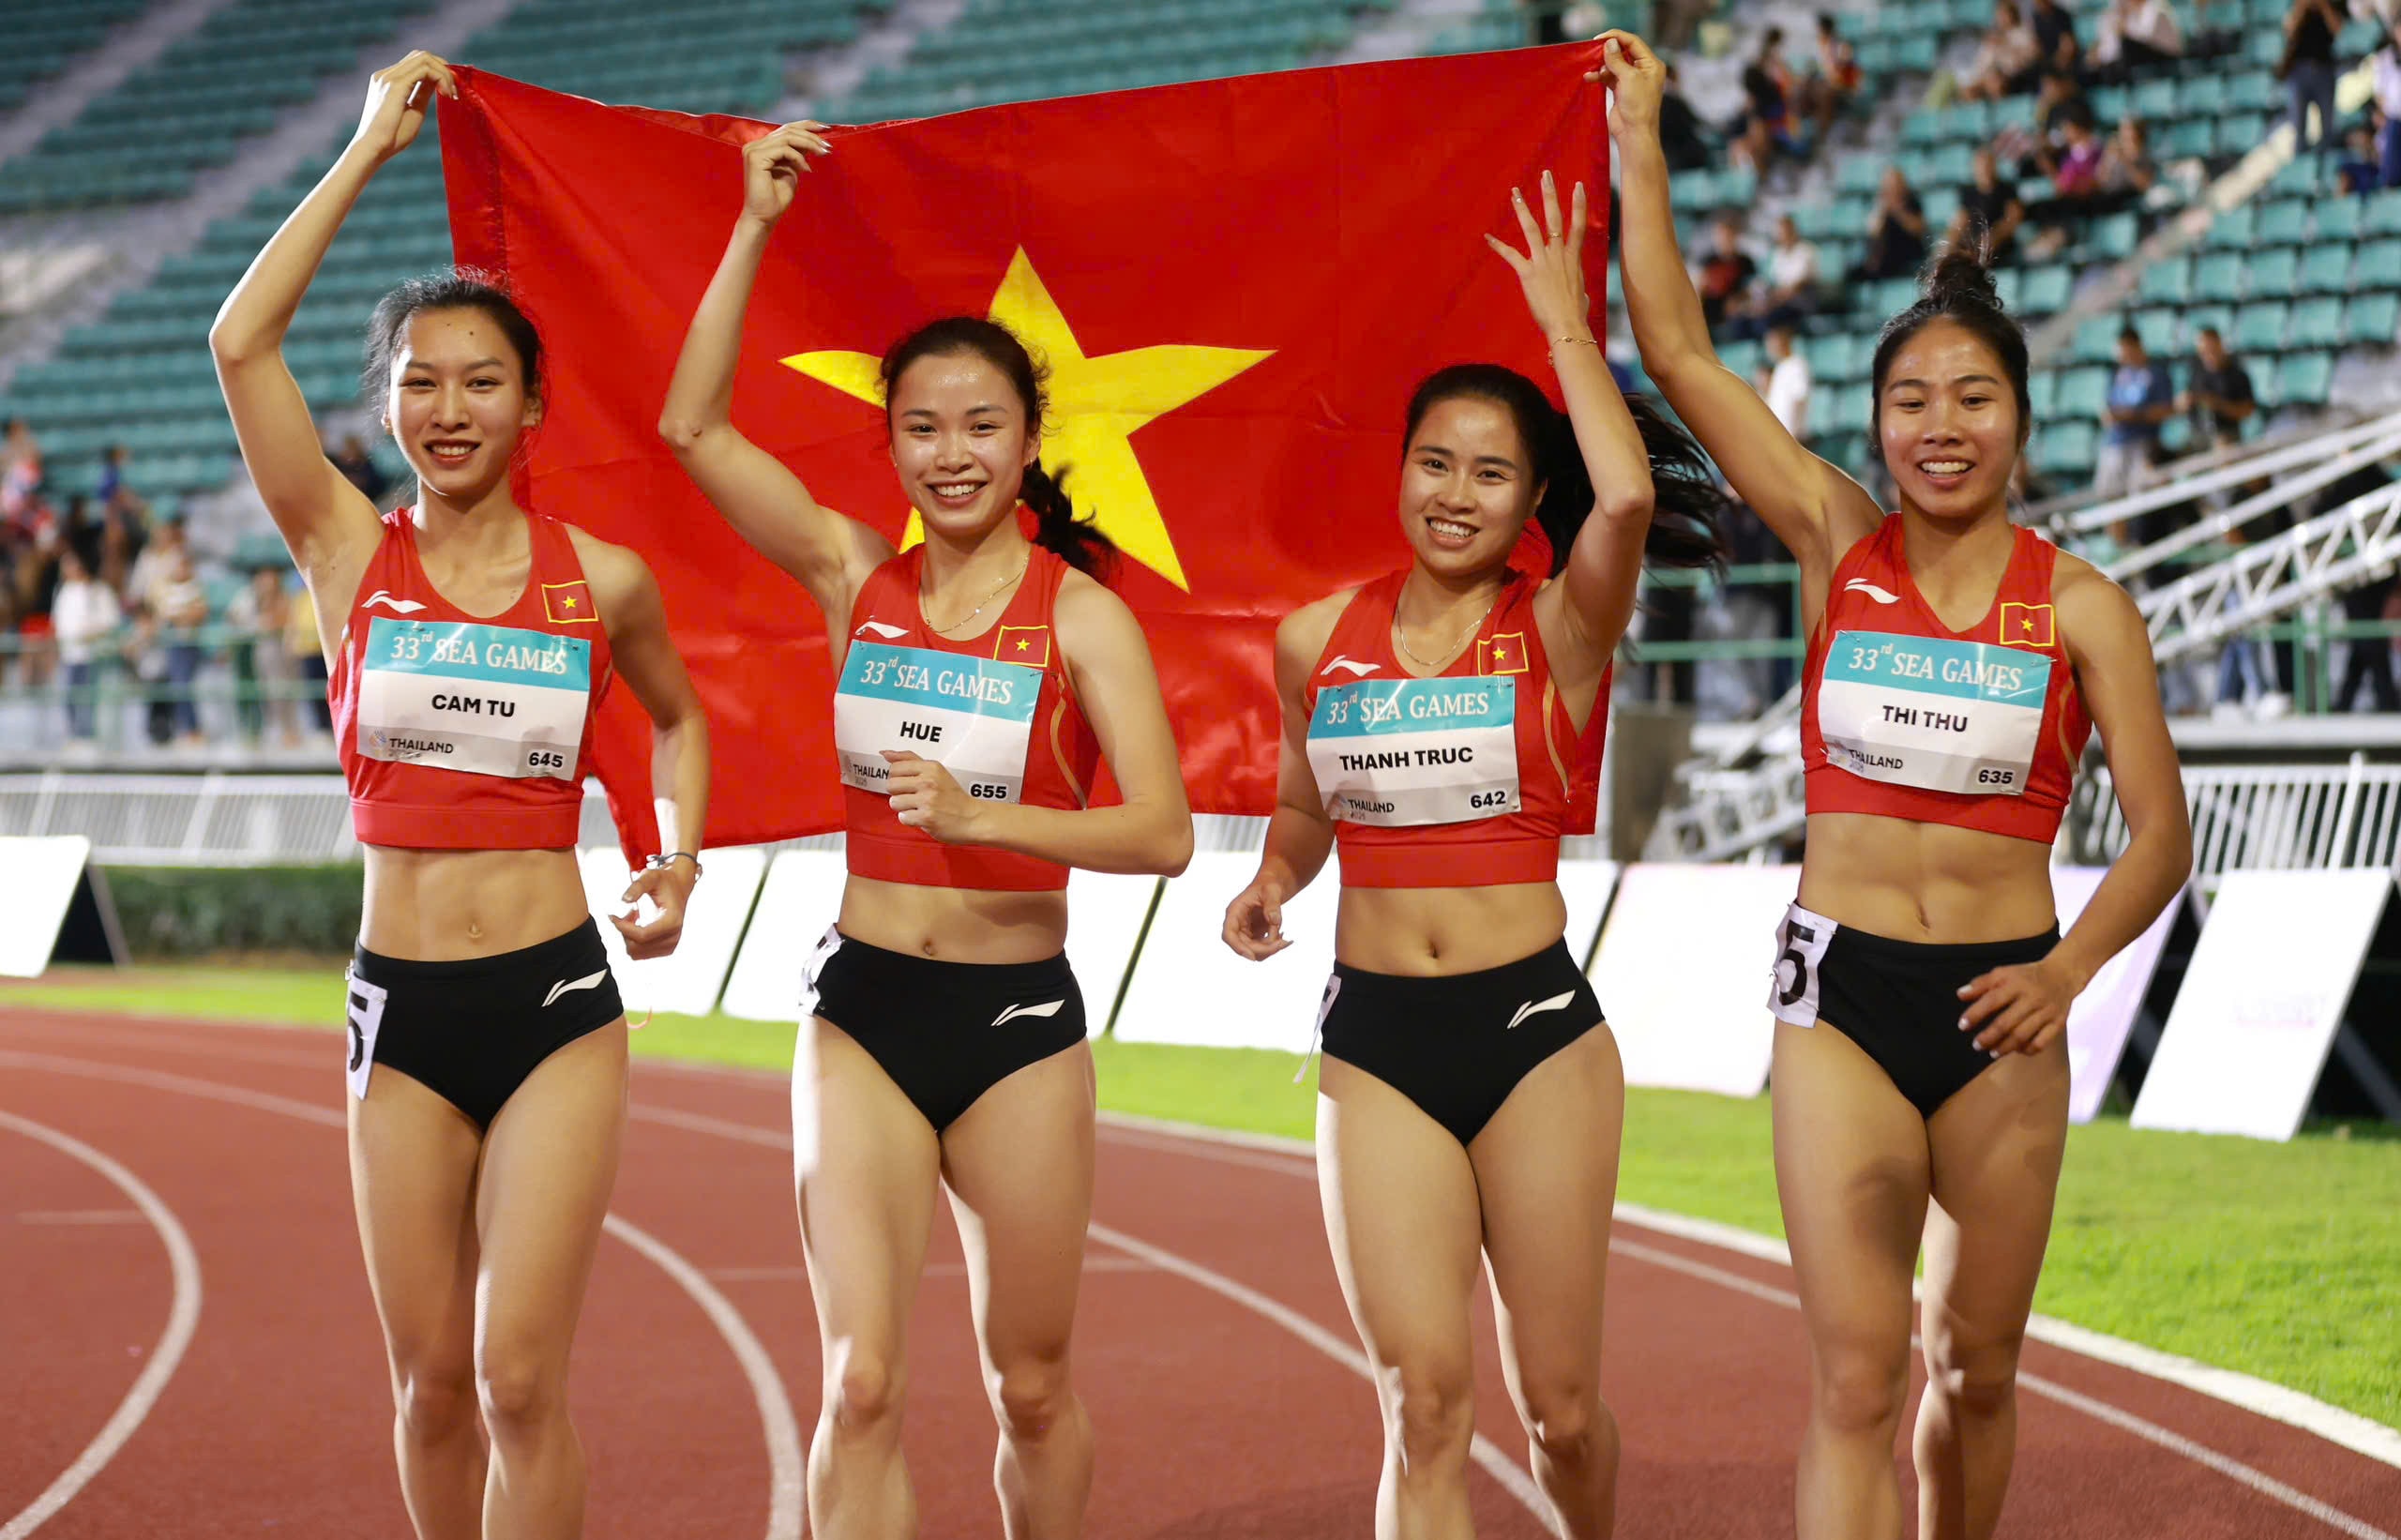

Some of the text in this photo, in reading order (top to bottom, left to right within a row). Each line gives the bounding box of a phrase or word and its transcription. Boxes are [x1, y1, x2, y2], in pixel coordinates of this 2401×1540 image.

[390, 631, 567, 674] 33rd SEA GAMES
[1849, 643, 2023, 691] 33rd SEA GAMES
[860, 657, 1014, 704] 33rd SEA GAMES
[431, 695, 515, 717] CAM TU
[1327, 690, 1489, 724] 33rd SEA GAMES
[1882, 705, 1969, 732] THI THU
[900, 721, 942, 742] HUE
[389, 737, 454, 754] THAILAND
[529, 752, 564, 768] 645
[1339, 747, 1473, 770] THANH TRUC
[1849, 748, 1904, 769] THAILAND
[853, 763, 889, 779] THAILAN
[1978, 769, 2014, 784] 635
[970, 784, 1007, 798] 655
[1471, 791, 1506, 808] 642
[1348, 799, 1395, 813] THAILAND
[1779, 920, 1816, 1006] 5
